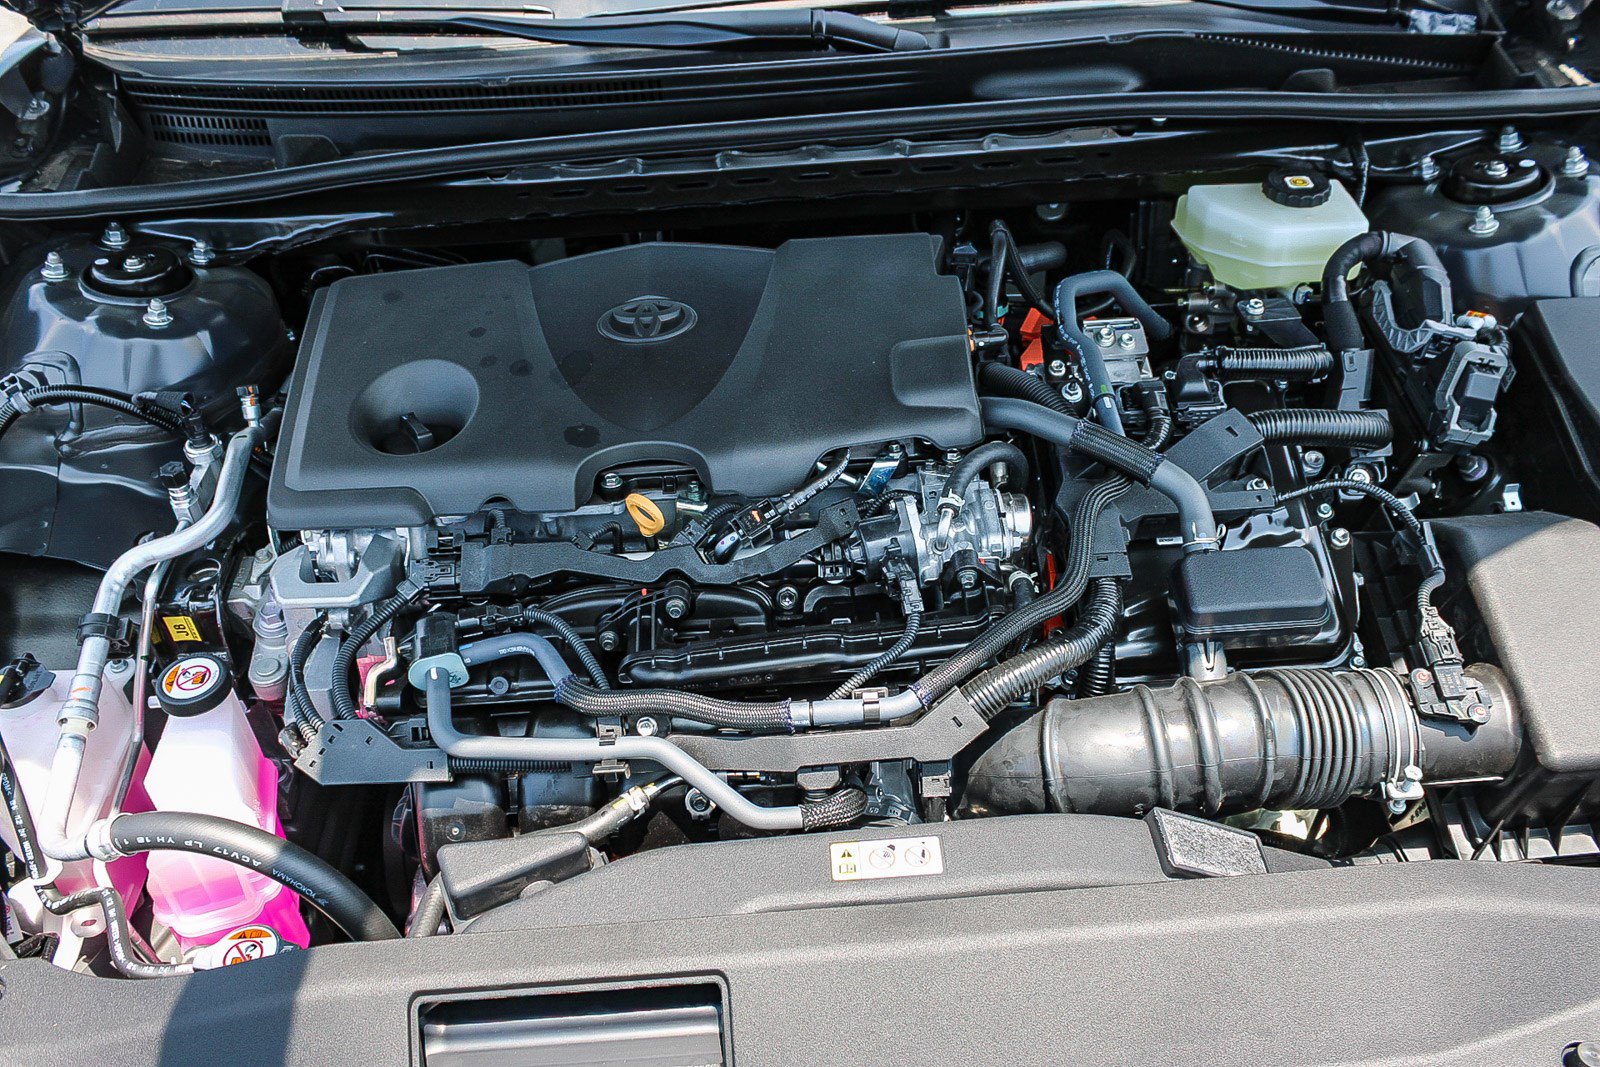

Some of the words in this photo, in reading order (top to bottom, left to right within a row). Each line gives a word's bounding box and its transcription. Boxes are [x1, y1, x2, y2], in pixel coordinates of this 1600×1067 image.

[156, 836, 175, 844] YH
[184, 839, 203, 849] LP
[212, 846, 262, 867] ACV17
[272, 868, 316, 899] YOKOHAMA
